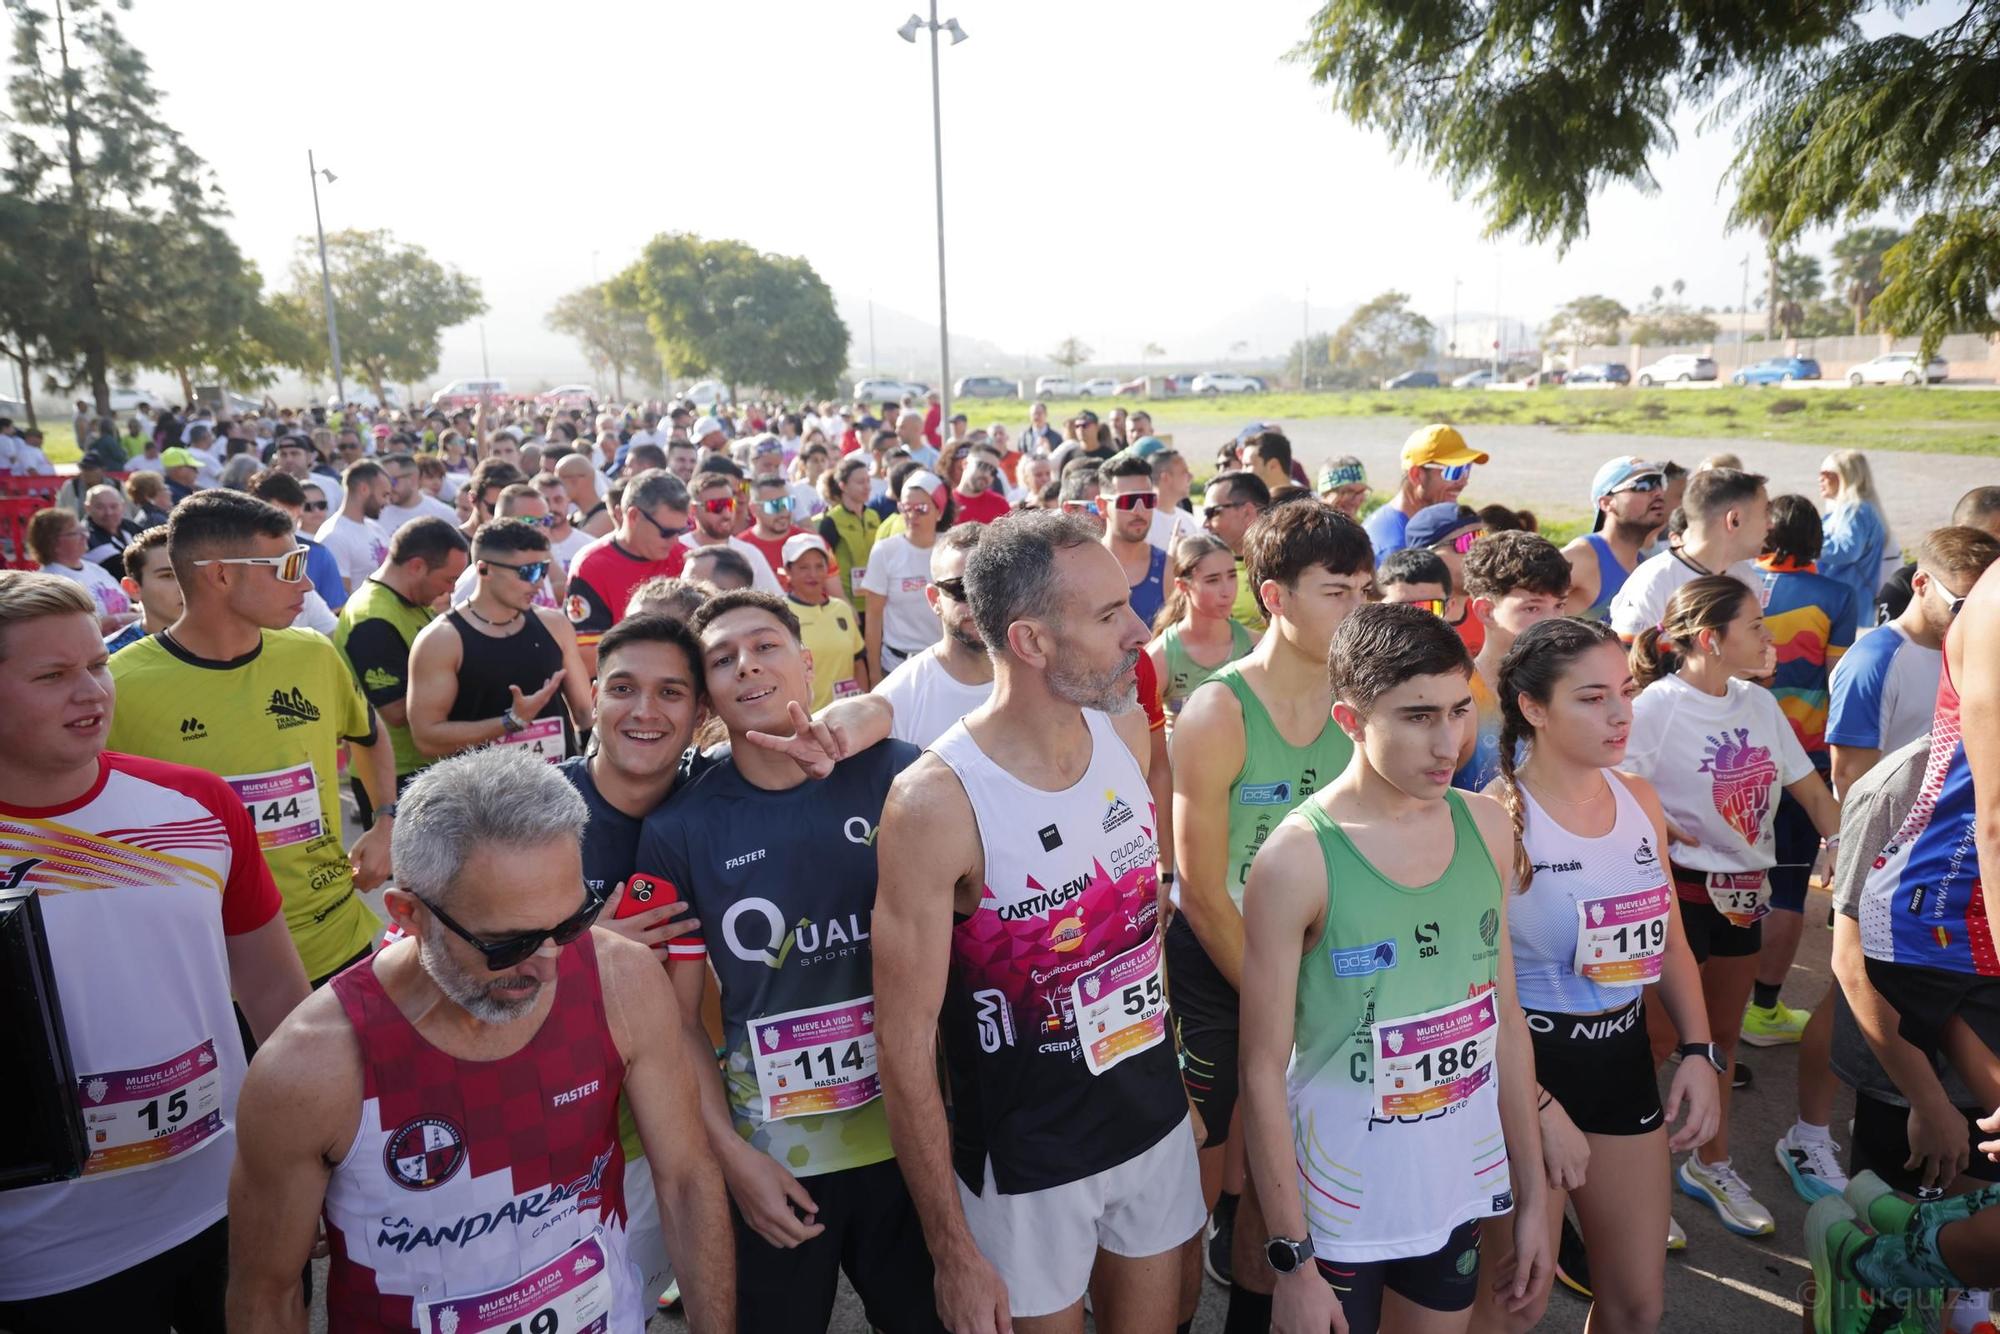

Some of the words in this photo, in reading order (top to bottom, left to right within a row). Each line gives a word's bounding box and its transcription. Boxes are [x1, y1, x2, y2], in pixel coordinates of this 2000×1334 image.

[272, 686, 320, 718] ALGAR
[182, 731, 208, 742] mobel
[242, 782, 268, 791] MUEVE
[279, 777, 294, 785] VIDA
[1299, 786, 1315, 796] SDL
[725, 849, 766, 870] FASTER
[1110, 835, 1145, 863] CIUDAD
[1113, 862, 1127, 880] DE
[998, 873, 1093, 921] CARTAGENA
[1616, 901, 1639, 910] MUEVE
[1648, 895, 1660, 904] VIDA
[1613, 919, 1664, 953] 119
[1419, 946, 1439, 959] SDL
[1628, 950, 1654, 960] JIMENA
[1111, 959, 1136, 976] MUEVE
[1137, 953, 1146, 964] LA
[1338, 953, 1371, 974] pds
[1122, 973, 1161, 1016] 55
[792, 1021, 820, 1033] MUEVE
[820, 1019, 831, 1028] LA
[833, 1015, 853, 1025] VIDA
[1140, 1008, 1157, 1020] EDU
[1570, 1006, 1635, 1040] NIKE
[1416, 1023, 1445, 1037] MUEVE
[1446, 1019, 1456, 1029] LA
[1456, 1014, 1473, 1024] VIDA
[1422, 1032, 1440, 1041] Carrera
[1444, 1026, 1459, 1035] Marcha
[794, 1040, 864, 1080] 114
[1416, 1040, 1478, 1082] 186
[126, 1072, 162, 1085] MUEVE
[164, 1067, 174, 1077] LA
[175, 1059, 192, 1072] VIDA
[814, 1076, 849, 1088] HASSAN
[1434, 1073, 1461, 1087] PABLO
[132, 1082, 156, 1090] Carrera
[553, 1080, 599, 1107] FASTER
[138, 1089, 188, 1130] 15
[154, 1125, 177, 1138] JAVI
[382, 1216, 414, 1229] C.A.
[478, 1291, 520, 1314] MUEVE
[522, 1284, 535, 1297] LA
[537, 1269, 562, 1287] VIDA
[487, 1305, 513, 1317] Carrera
[518, 1291, 541, 1305] Marcha
[542, 1278, 563, 1293] Urbana
